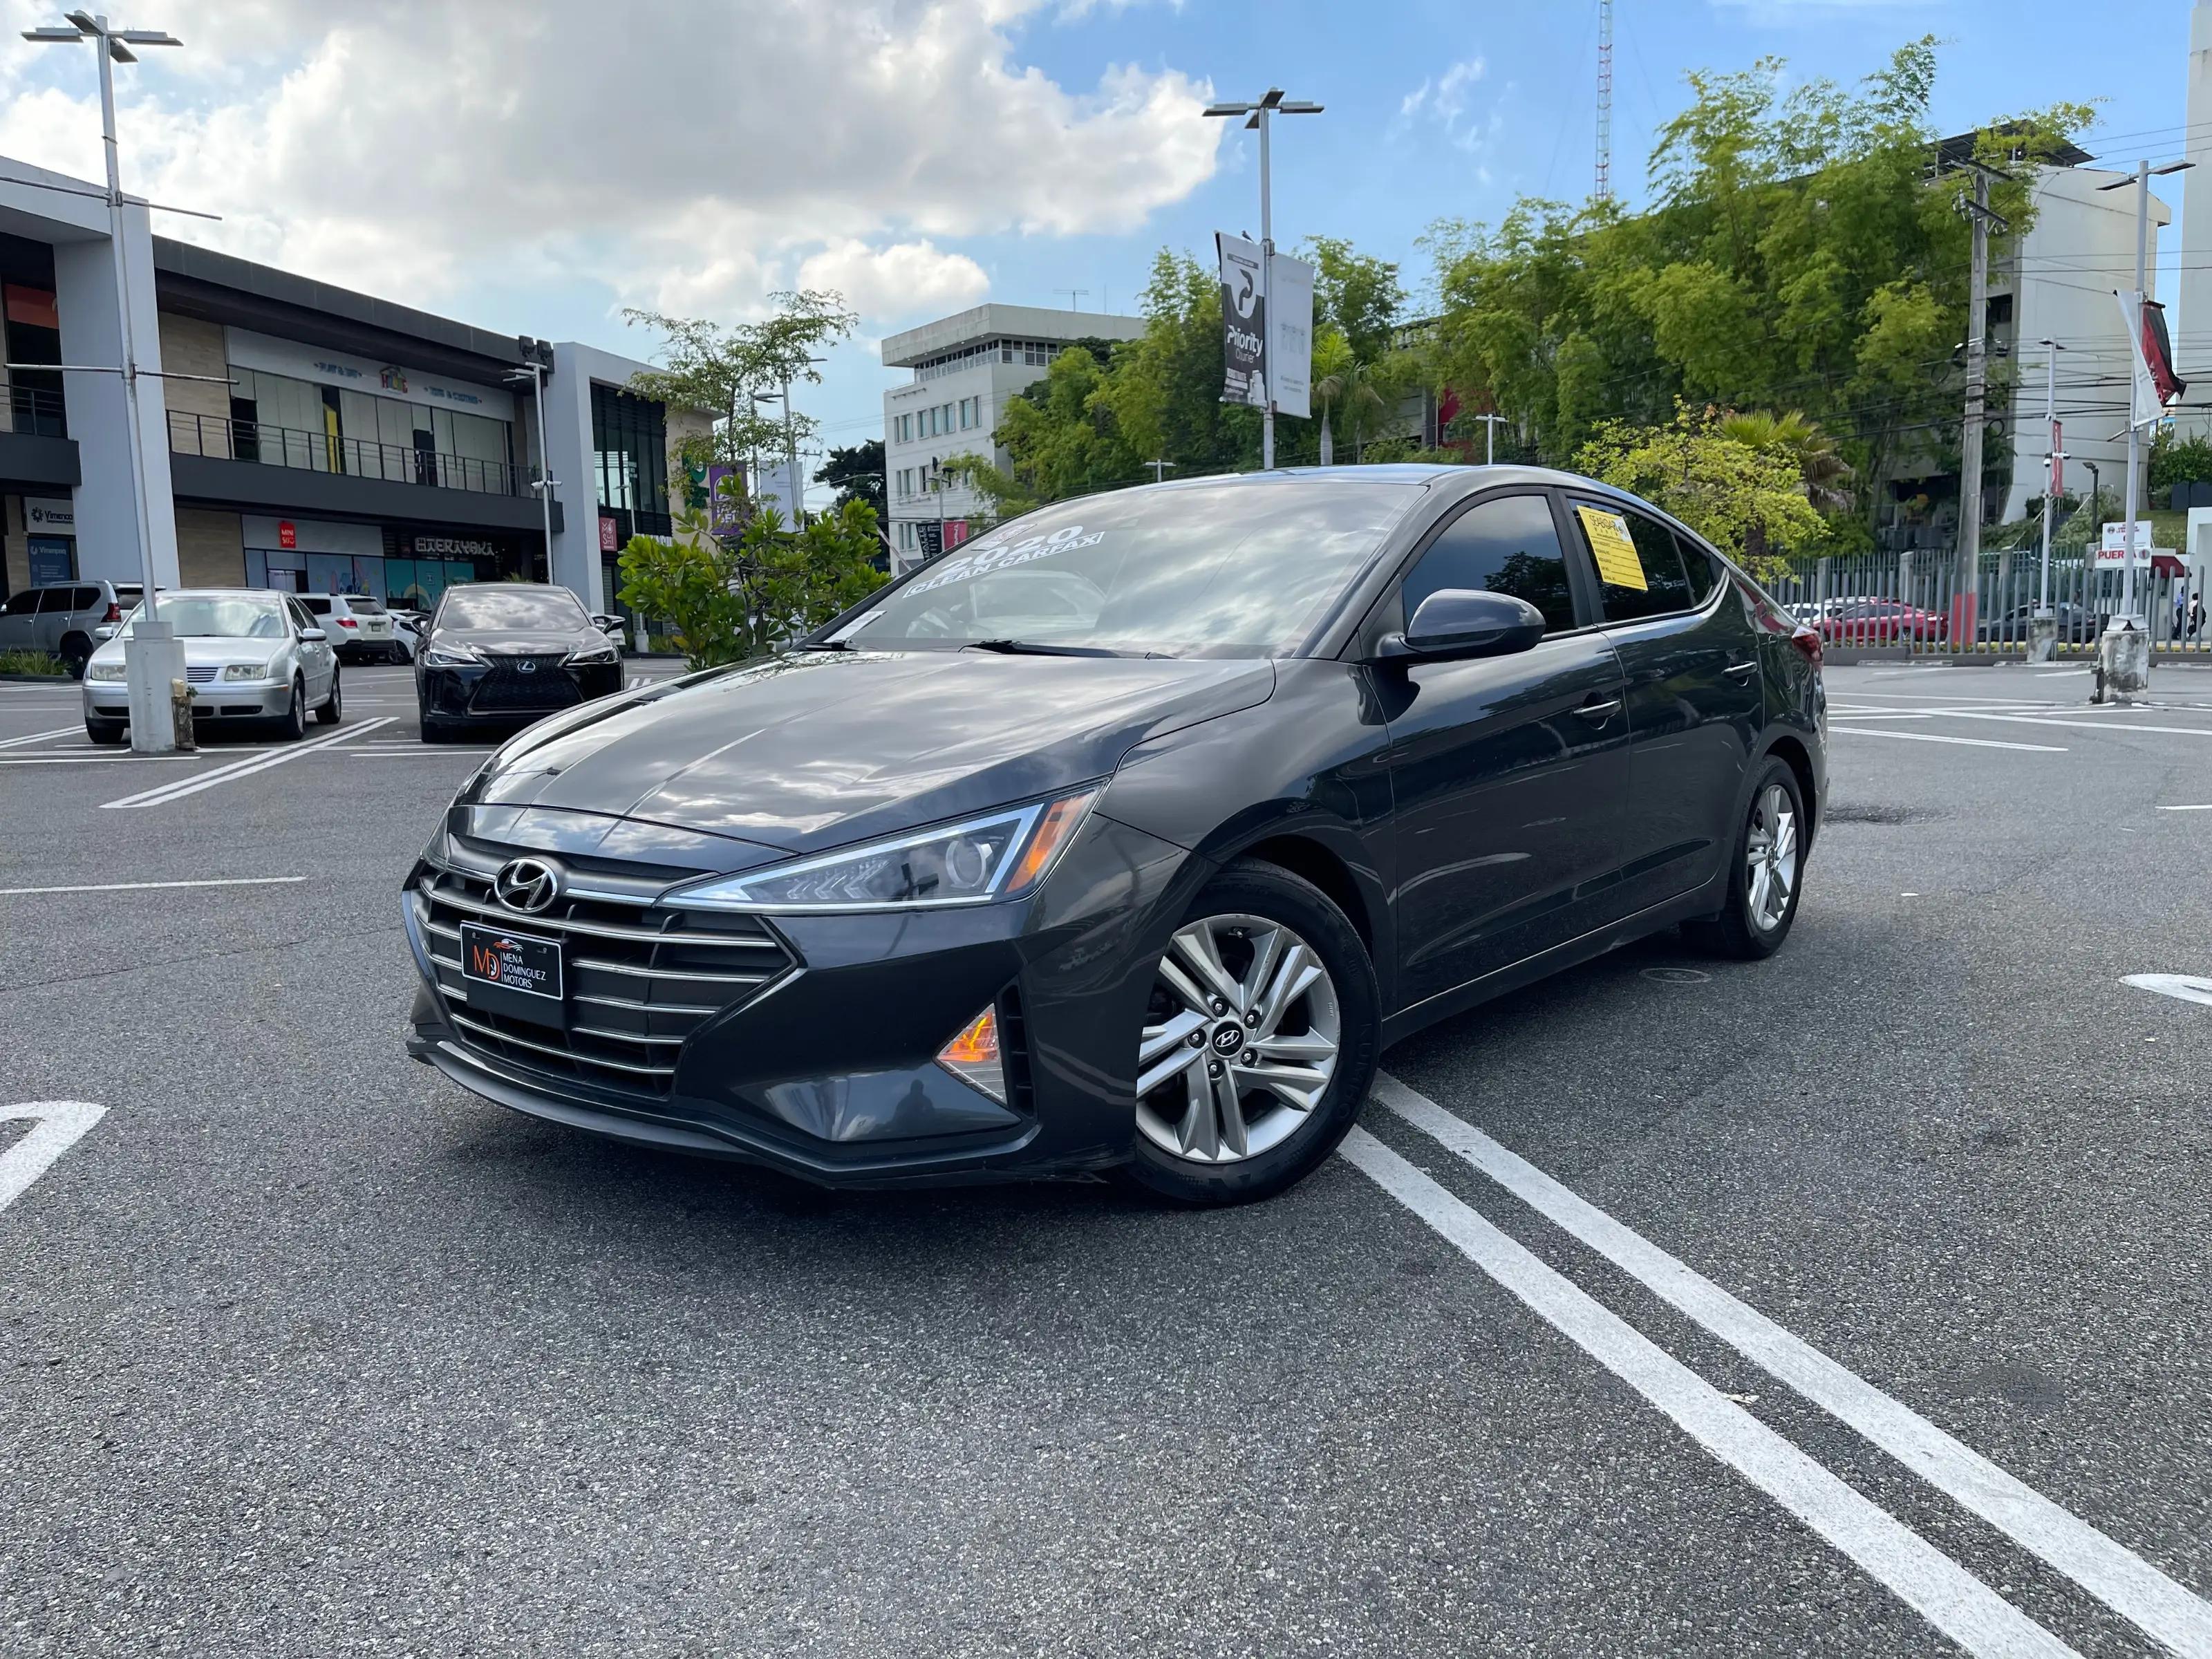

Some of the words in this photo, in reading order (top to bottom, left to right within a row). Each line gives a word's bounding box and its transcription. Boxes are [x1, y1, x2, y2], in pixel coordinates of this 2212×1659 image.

[1227, 324, 1263, 357] Priority
[934, 525, 1083, 579] 2020
[2098, 550, 2137, 559] PUER
[910, 563, 992, 594] CLEAN
[1000, 534, 1098, 566] CARFAX
[503, 952, 524, 965] MENA
[503, 964, 547, 981] DOMINGUEZ
[504, 973, 532, 988] MOTORS
